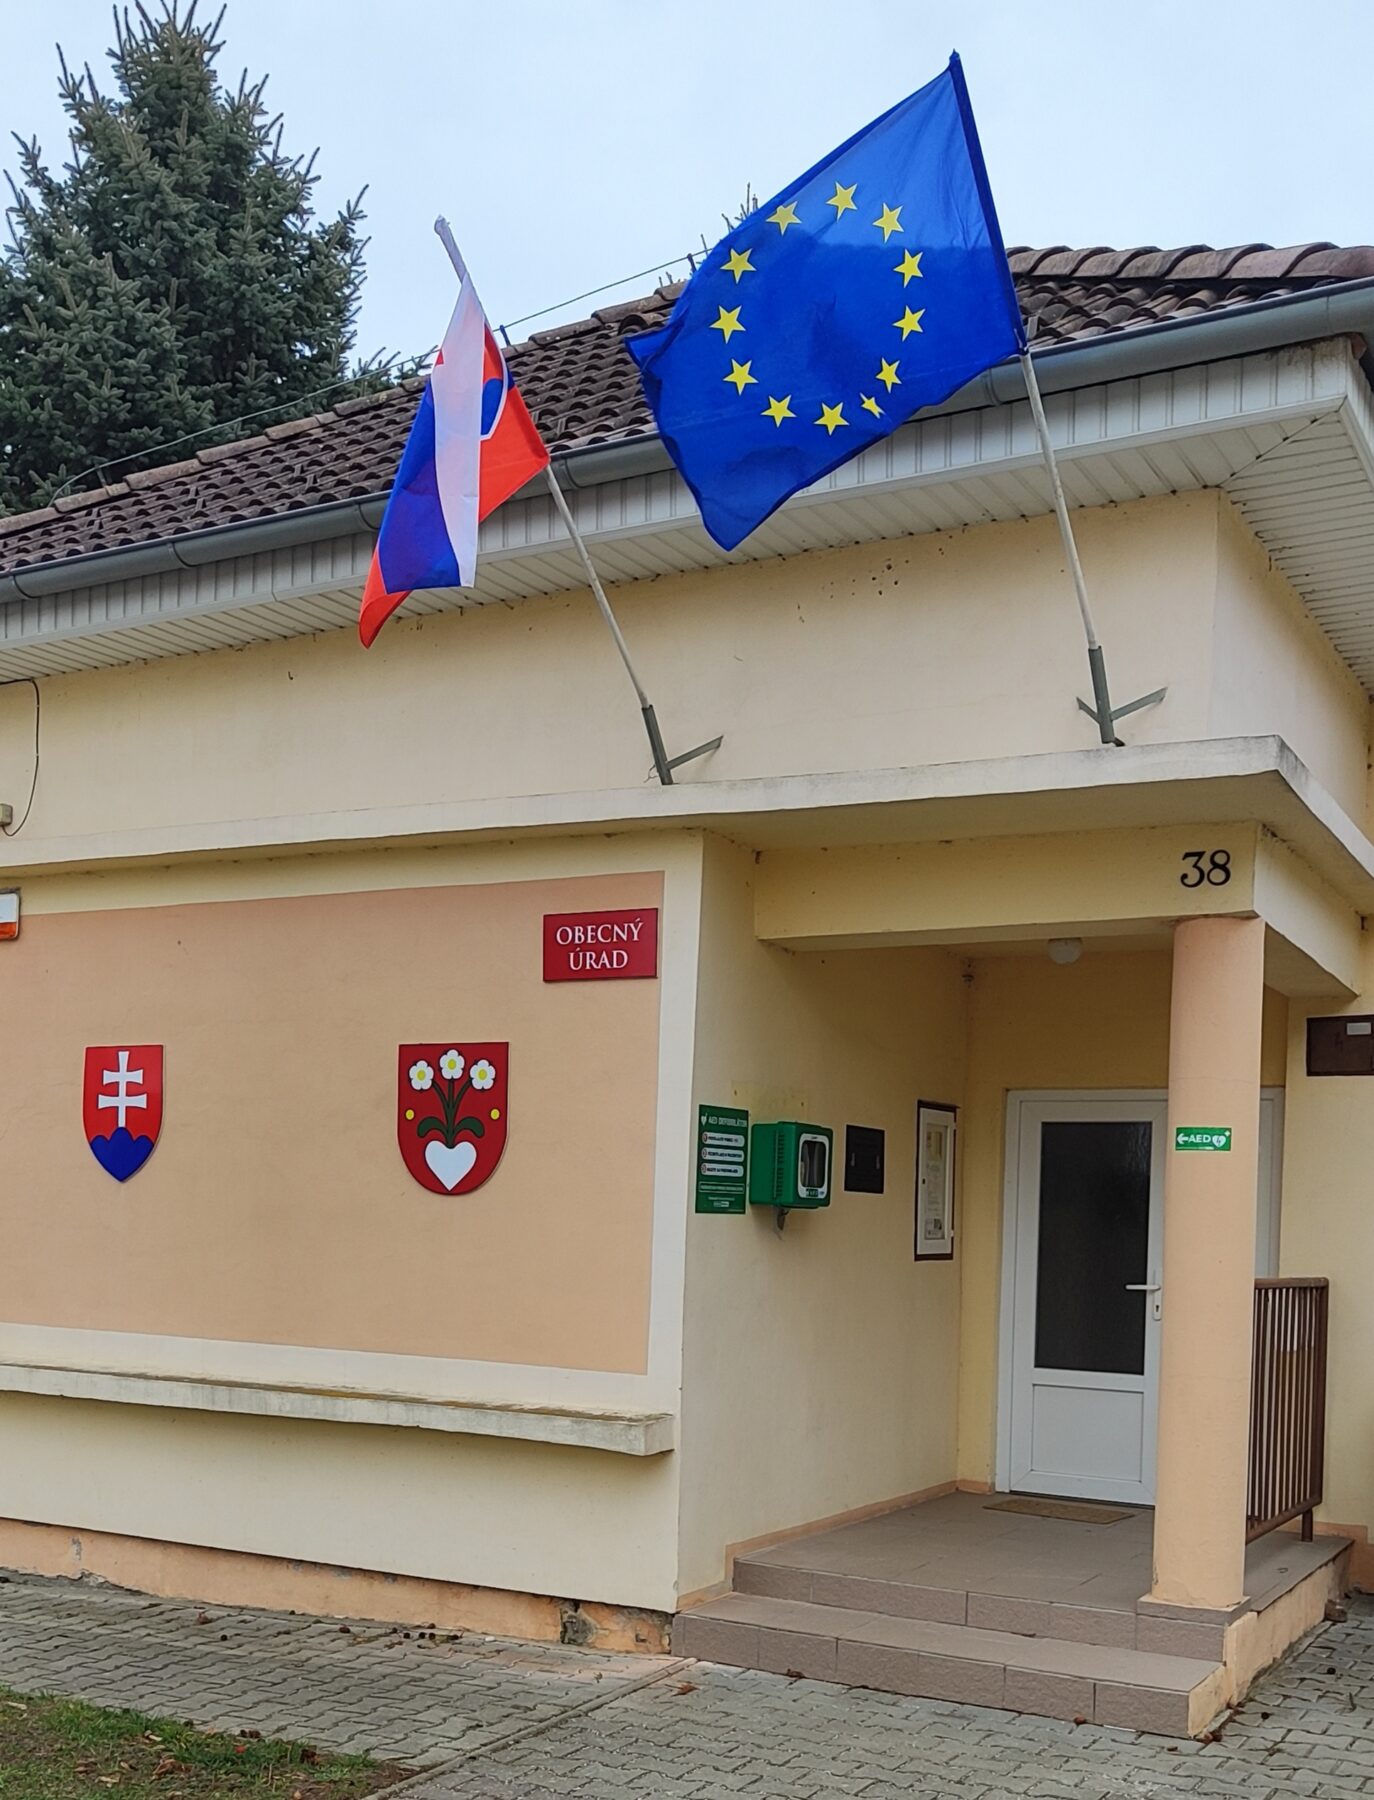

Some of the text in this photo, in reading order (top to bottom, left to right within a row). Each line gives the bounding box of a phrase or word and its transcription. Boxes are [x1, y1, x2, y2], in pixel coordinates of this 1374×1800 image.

[1180, 849, 1231, 888] 38
[556, 917, 643, 945] OBECNÝ
[569, 947, 628, 970] ÚRAD
[1188, 1134, 1211, 1143] AED
